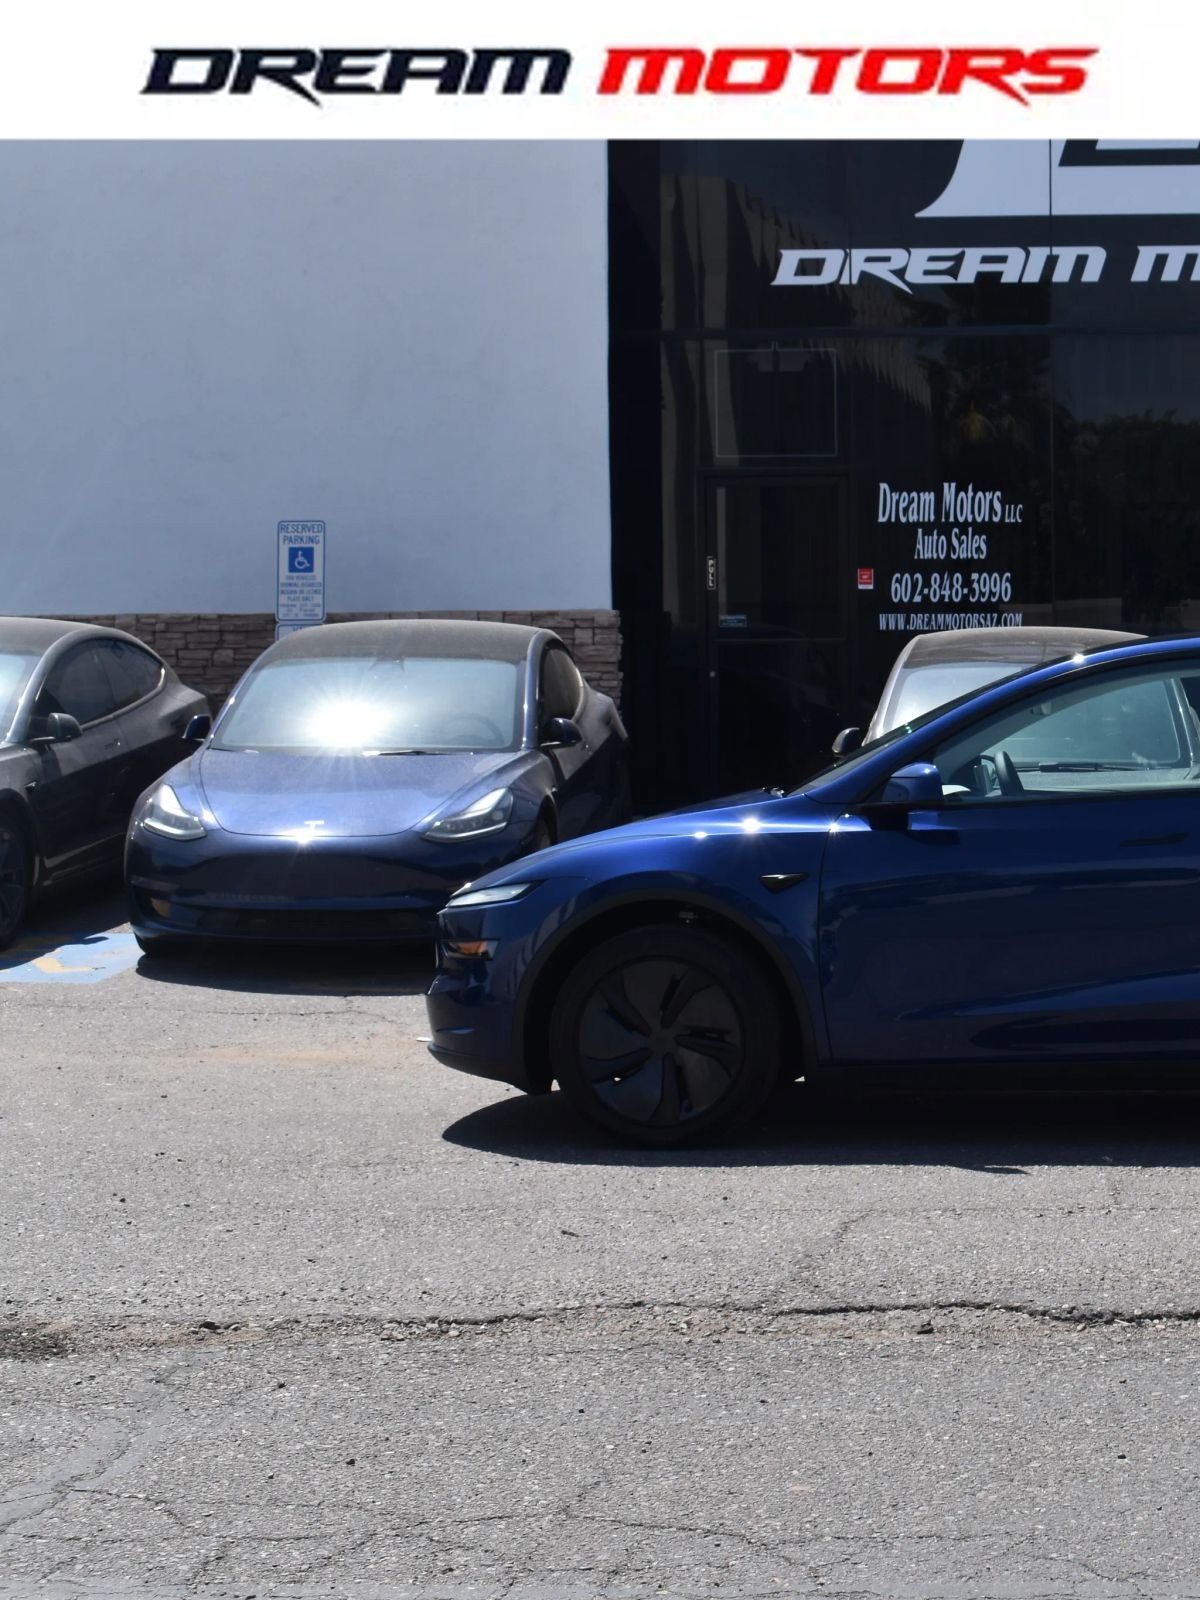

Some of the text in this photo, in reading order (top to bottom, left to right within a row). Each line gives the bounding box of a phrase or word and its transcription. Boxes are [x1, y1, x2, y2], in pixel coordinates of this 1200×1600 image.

[770, 245, 1108, 295] DREAM
[877, 481, 1023, 523] Dream Motors LLC
[280, 523, 323, 533] RESERVED
[283, 535, 320, 544] PARKING
[913, 526, 987, 560] Auto Sales
[890, 571, 1012, 603] 602-848-3996
[879, 612, 1022, 631] WWW.DREAMMOTORSAZ.COM
